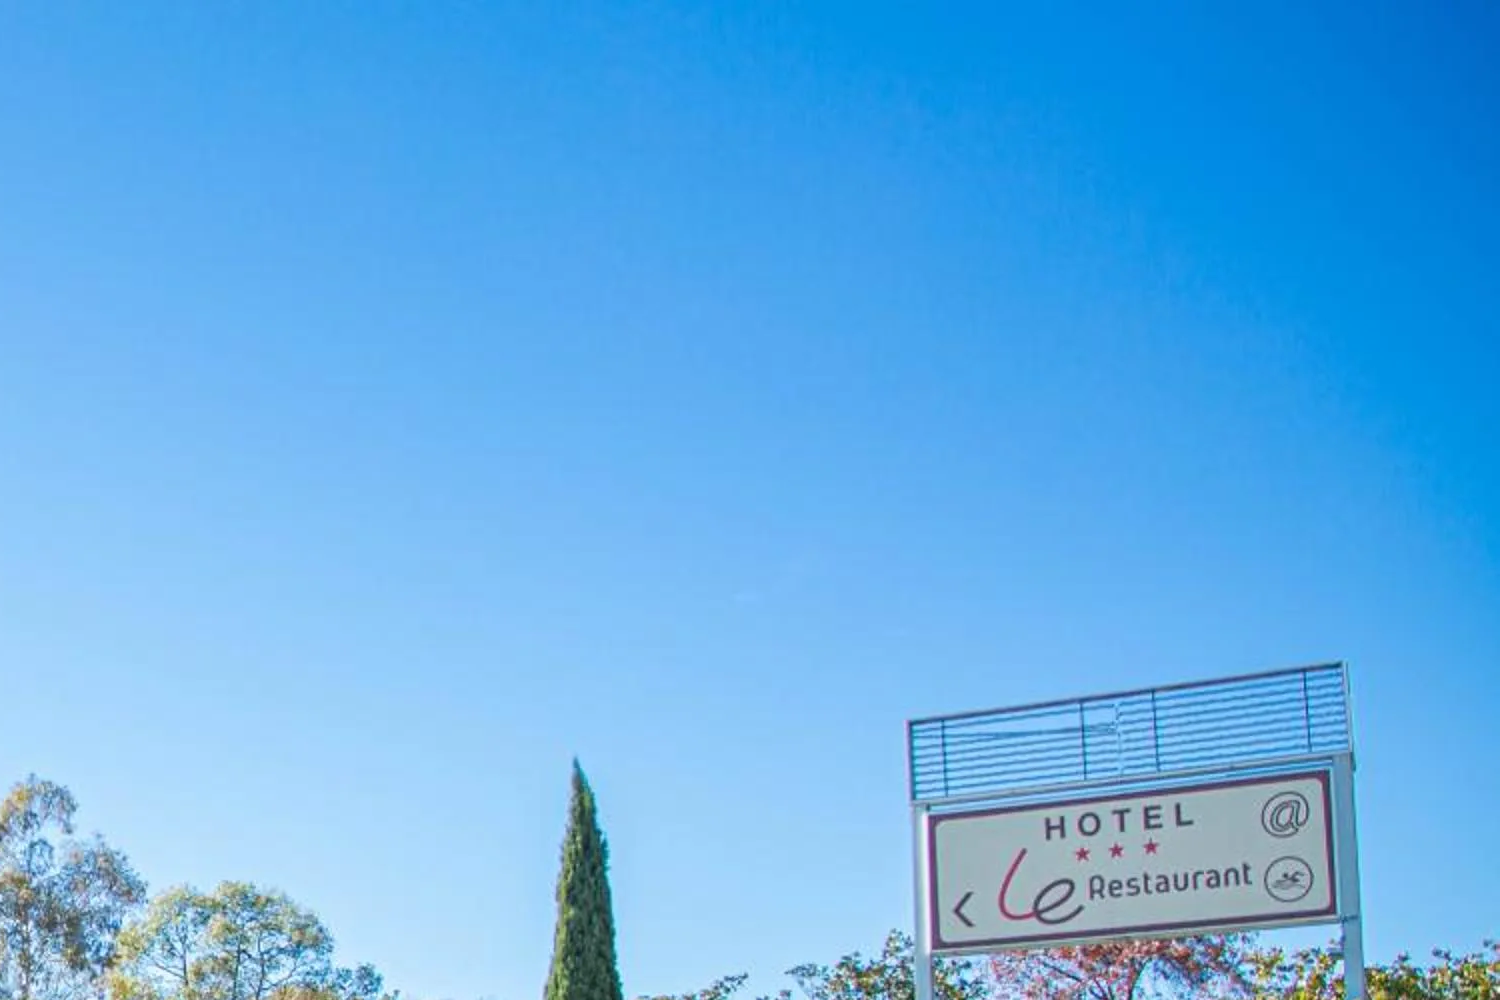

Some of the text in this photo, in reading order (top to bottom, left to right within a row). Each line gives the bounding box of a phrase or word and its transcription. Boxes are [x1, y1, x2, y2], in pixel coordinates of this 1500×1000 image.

[1044, 802, 1195, 841] HOTEL
[999, 847, 1253, 925] Le Restaurant
